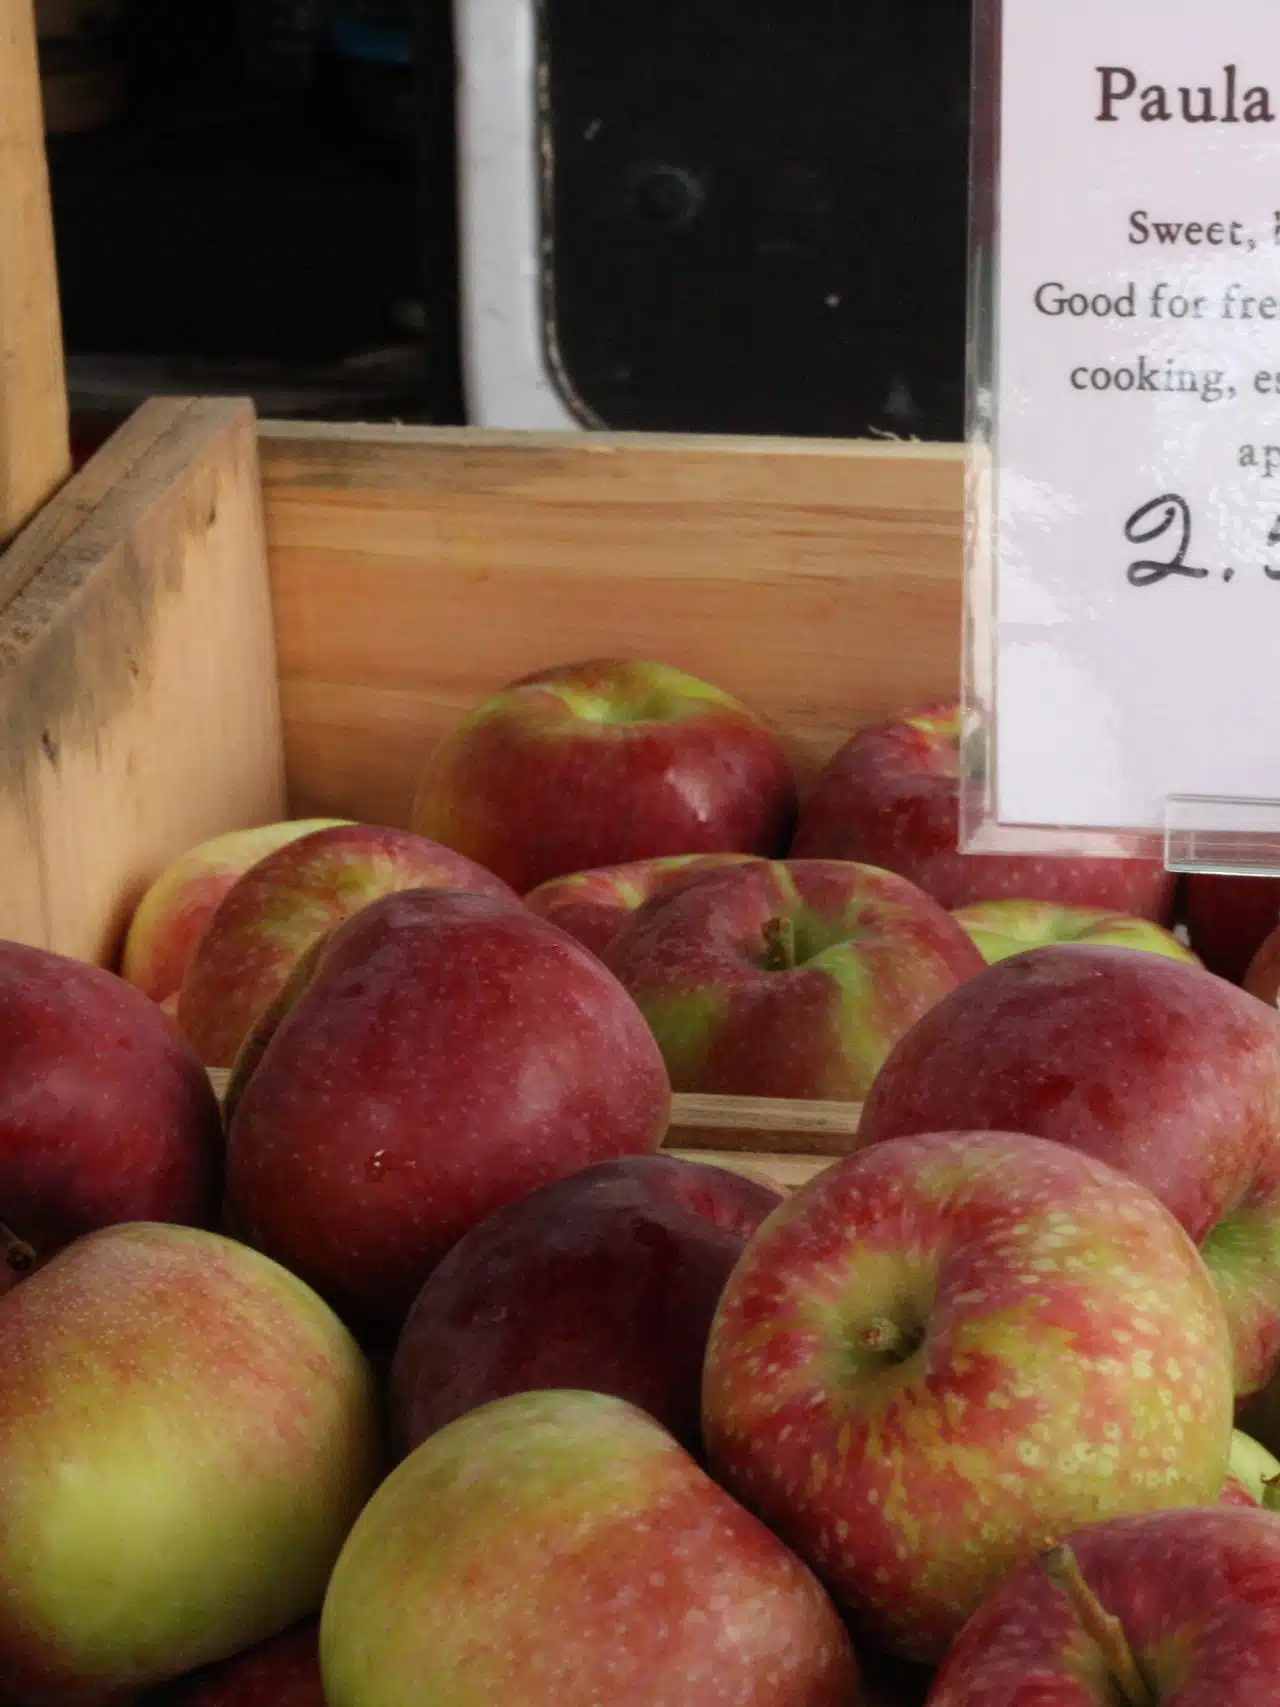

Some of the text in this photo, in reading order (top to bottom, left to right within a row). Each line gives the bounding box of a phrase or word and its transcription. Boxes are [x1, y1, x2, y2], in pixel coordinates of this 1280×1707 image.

[1095, 64, 1275, 125] Paula
[1128, 210, 1256, 252] Sweet,
[1034, 282, 1136, 317] Good
[1149, 283, 1209, 319] for
[1070, 356, 1237, 403] cooking,
